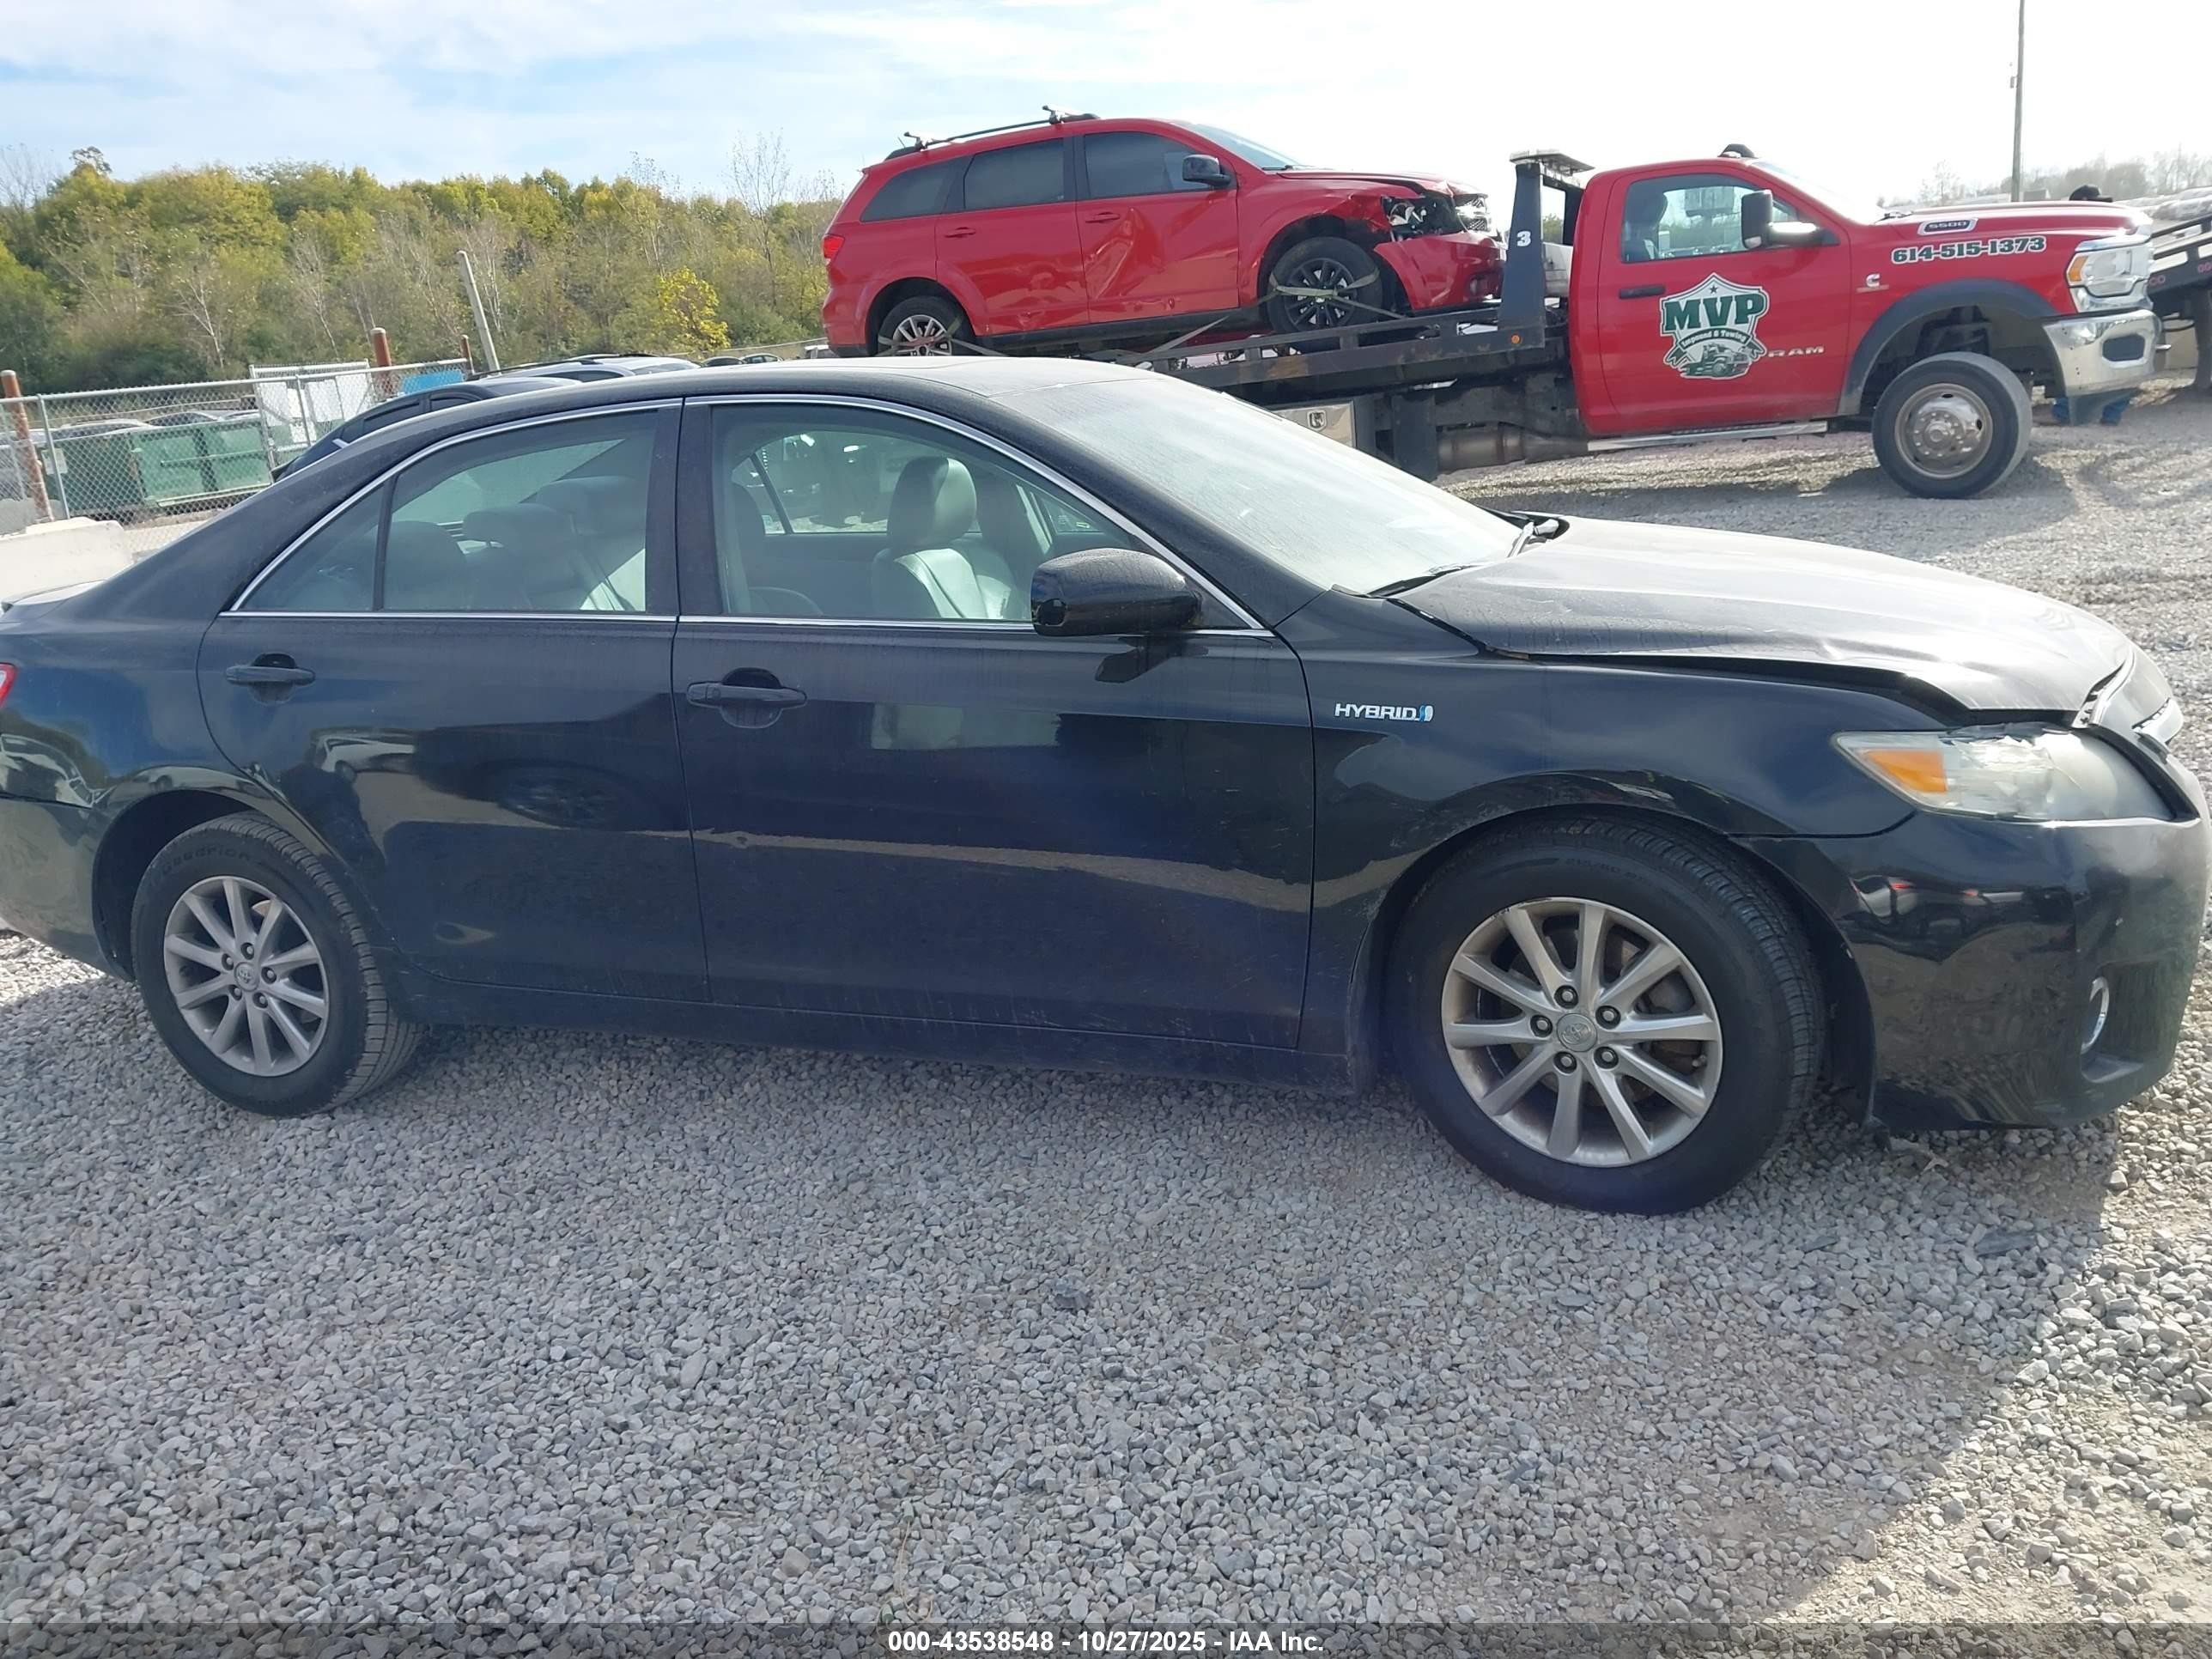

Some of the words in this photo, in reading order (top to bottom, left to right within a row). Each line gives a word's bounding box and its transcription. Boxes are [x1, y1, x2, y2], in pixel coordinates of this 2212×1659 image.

[1928, 221, 1967, 229] 5500
[1516, 230, 1532, 247] 3
[1893, 236, 2045, 263] 614-515-1373
[1664, 293, 1765, 331] MVP
[1768, 346, 1825, 357] RAM
[1334, 702, 1418, 721] HYBRID
